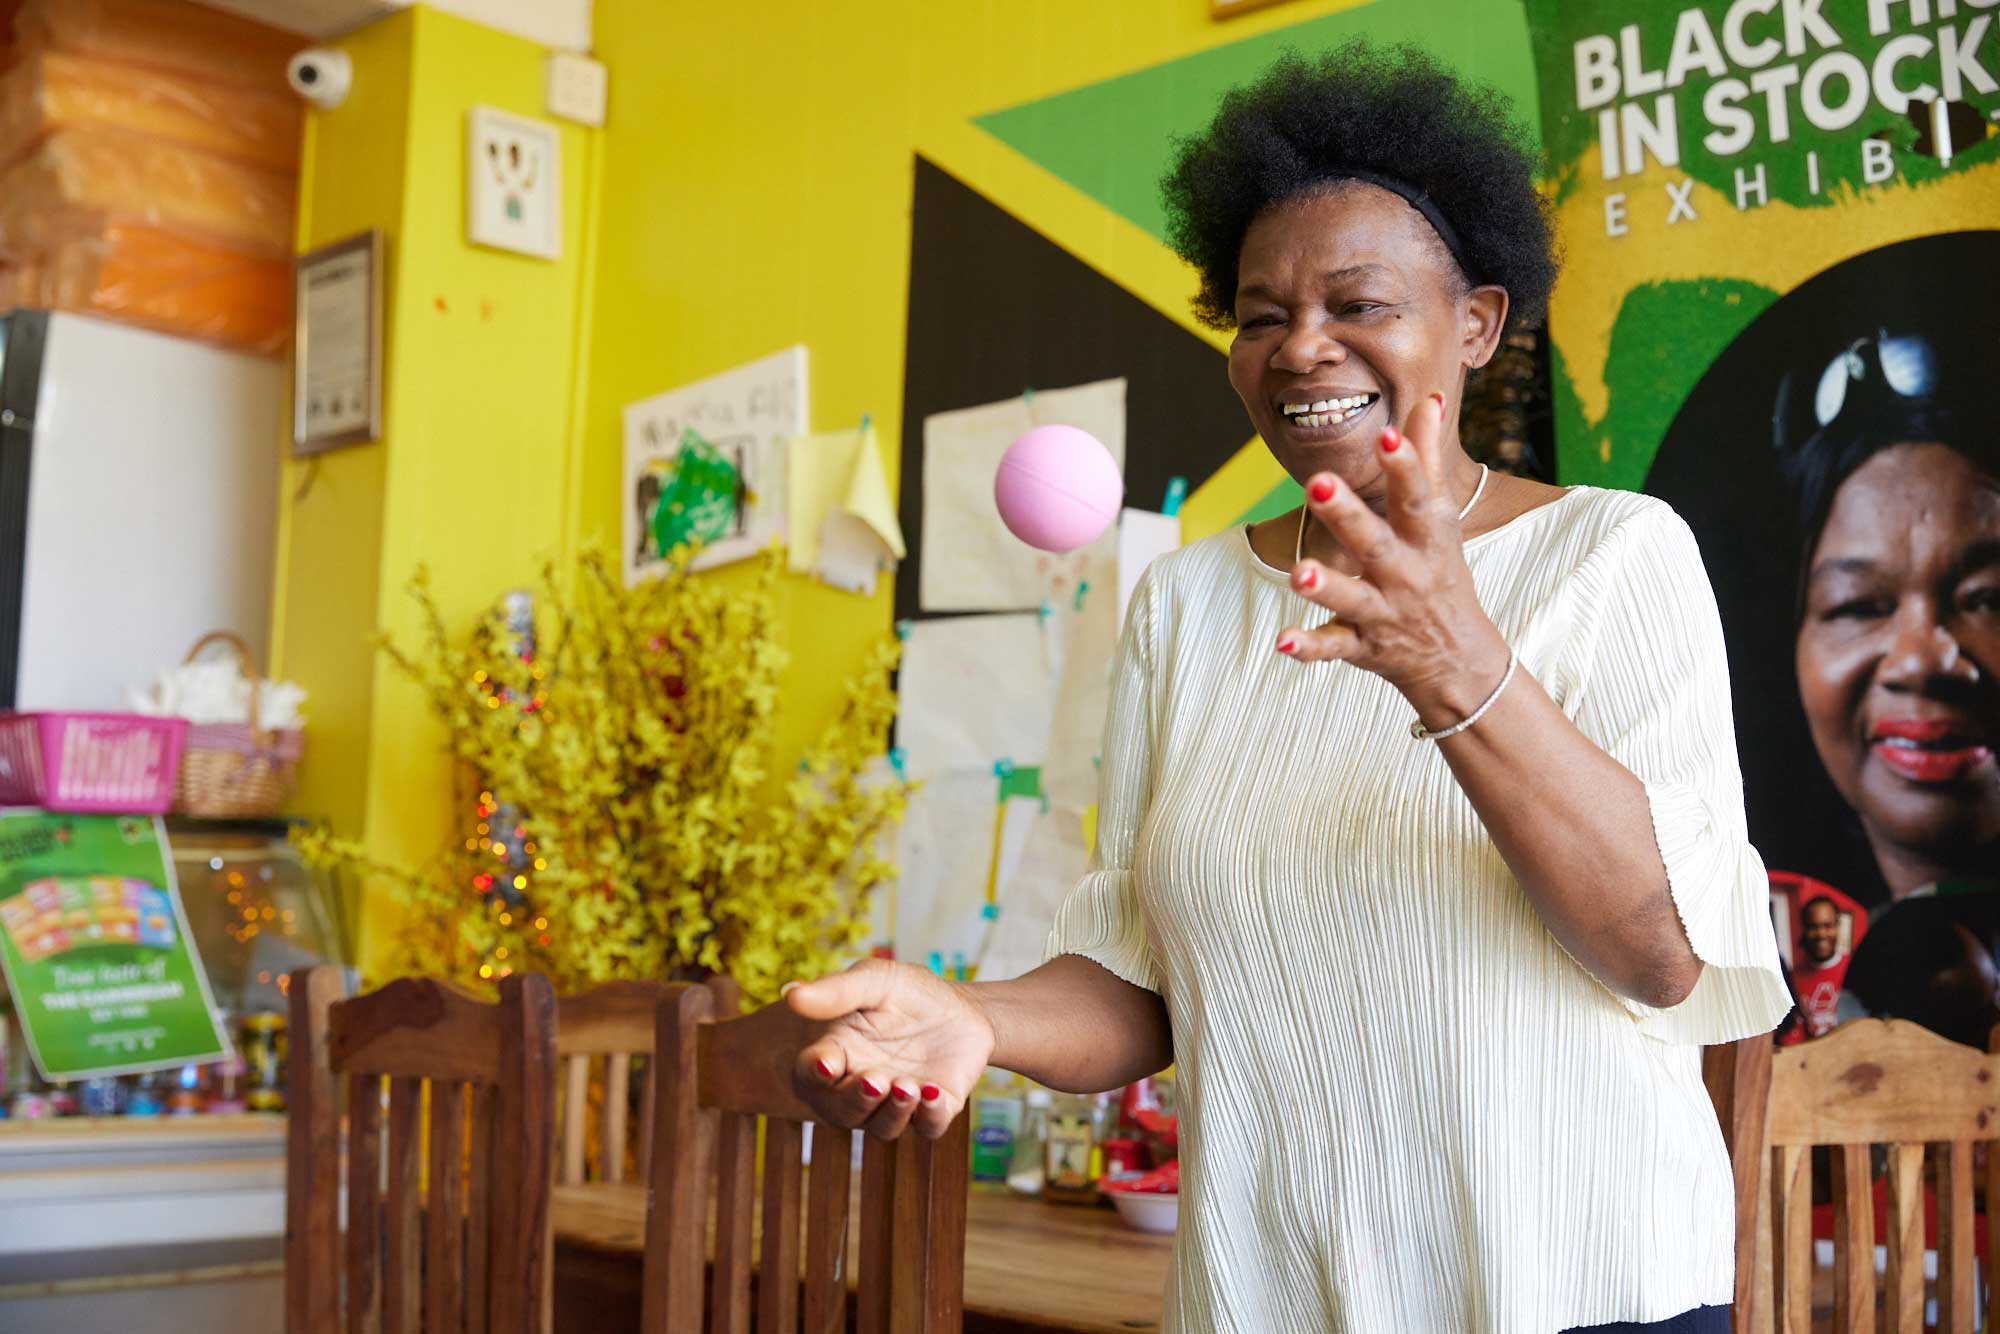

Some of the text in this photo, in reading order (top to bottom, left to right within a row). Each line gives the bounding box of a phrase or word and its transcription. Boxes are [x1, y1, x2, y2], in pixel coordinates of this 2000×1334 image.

[1573, 0, 1842, 110] BLACK
[1598, 14, 2000, 180] IN STOCK
[1604, 108, 2000, 237] EXHIB
